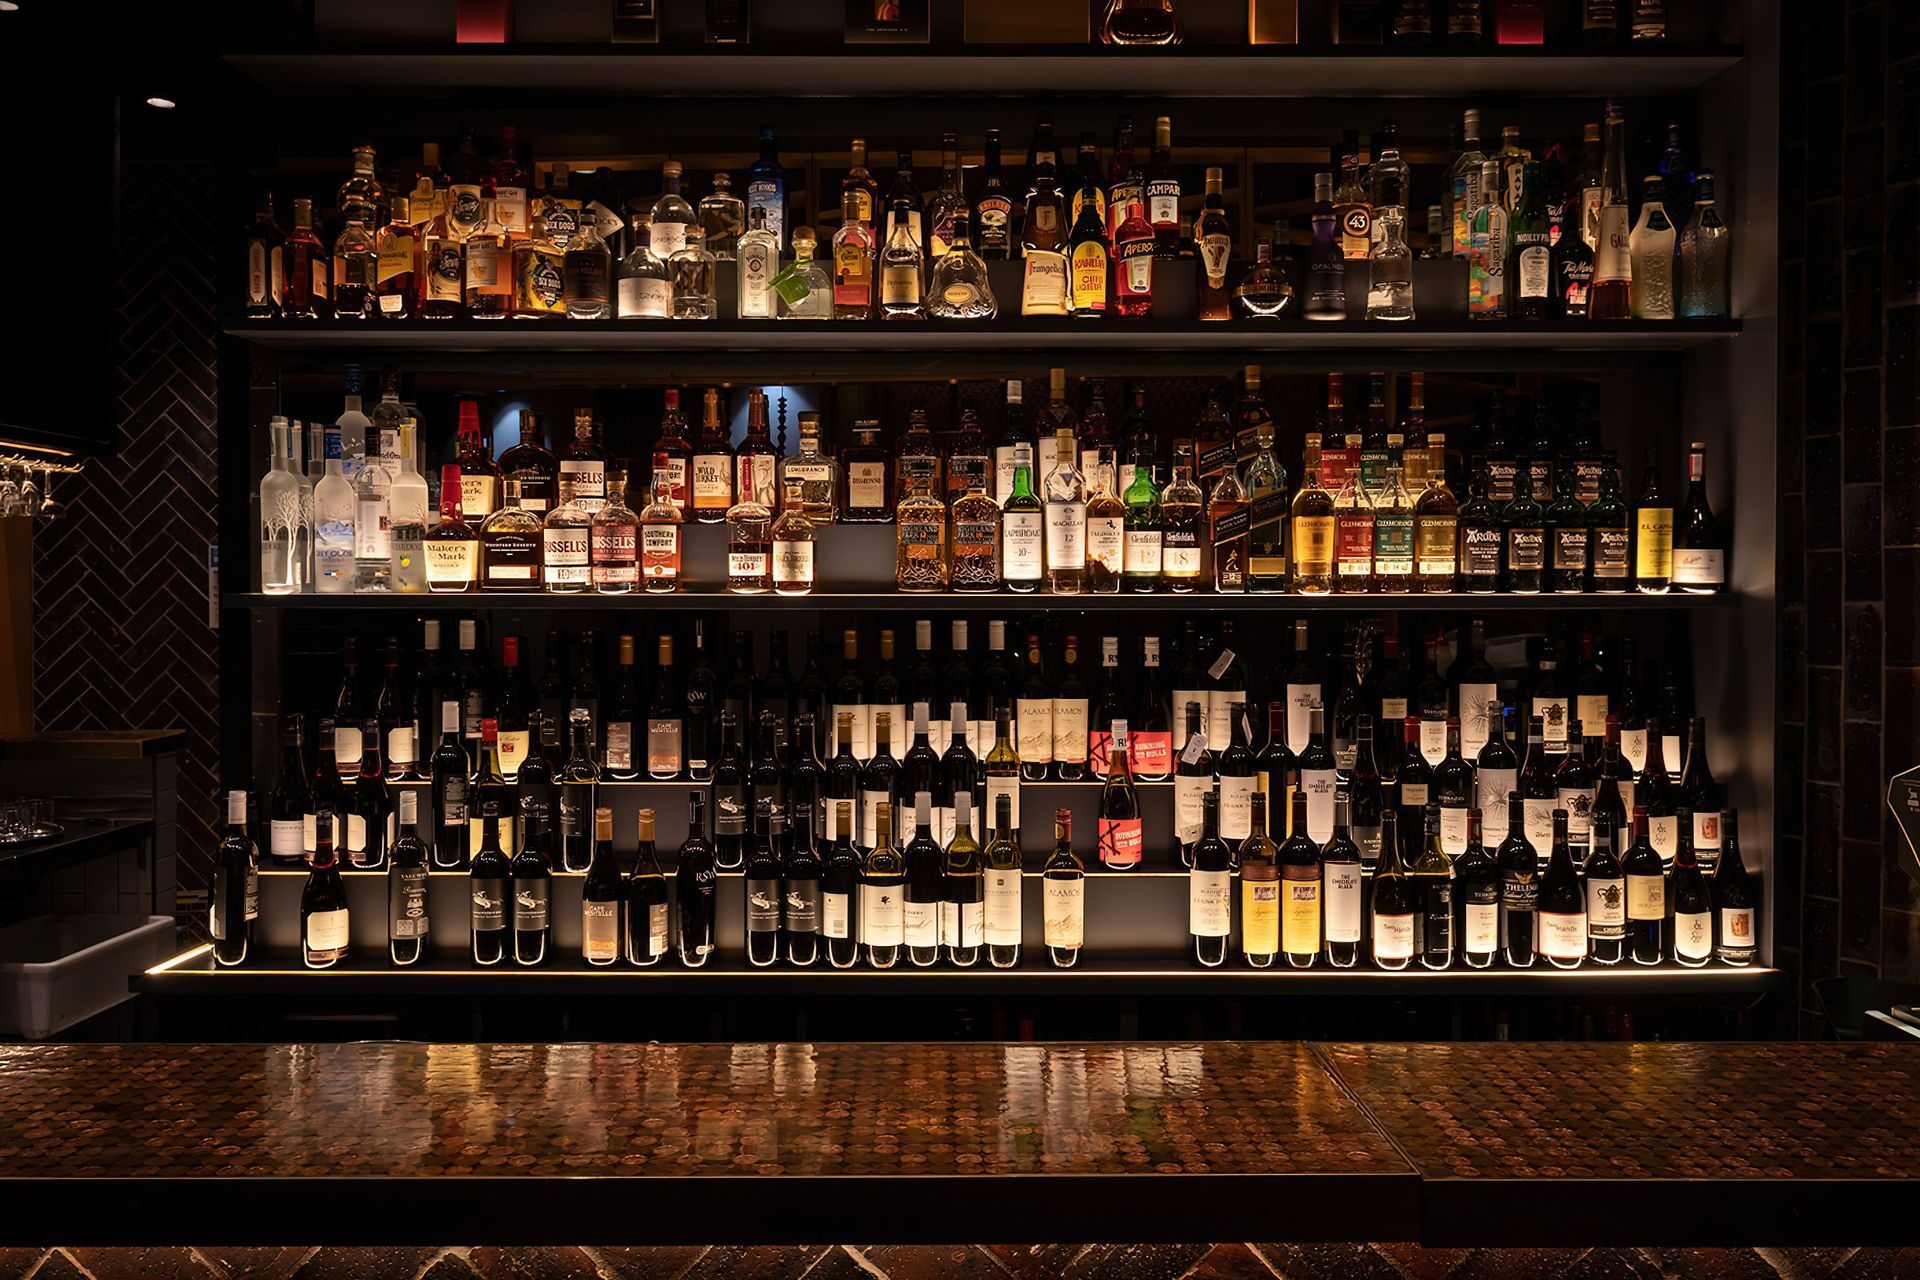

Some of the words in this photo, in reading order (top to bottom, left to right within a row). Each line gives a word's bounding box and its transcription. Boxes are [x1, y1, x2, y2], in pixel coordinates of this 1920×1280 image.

[1349, 214, 1367, 230] 43
[427, 544, 468, 554] Maker's
[438, 552, 467, 562] Mark
[737, 562, 756, 570] 101
